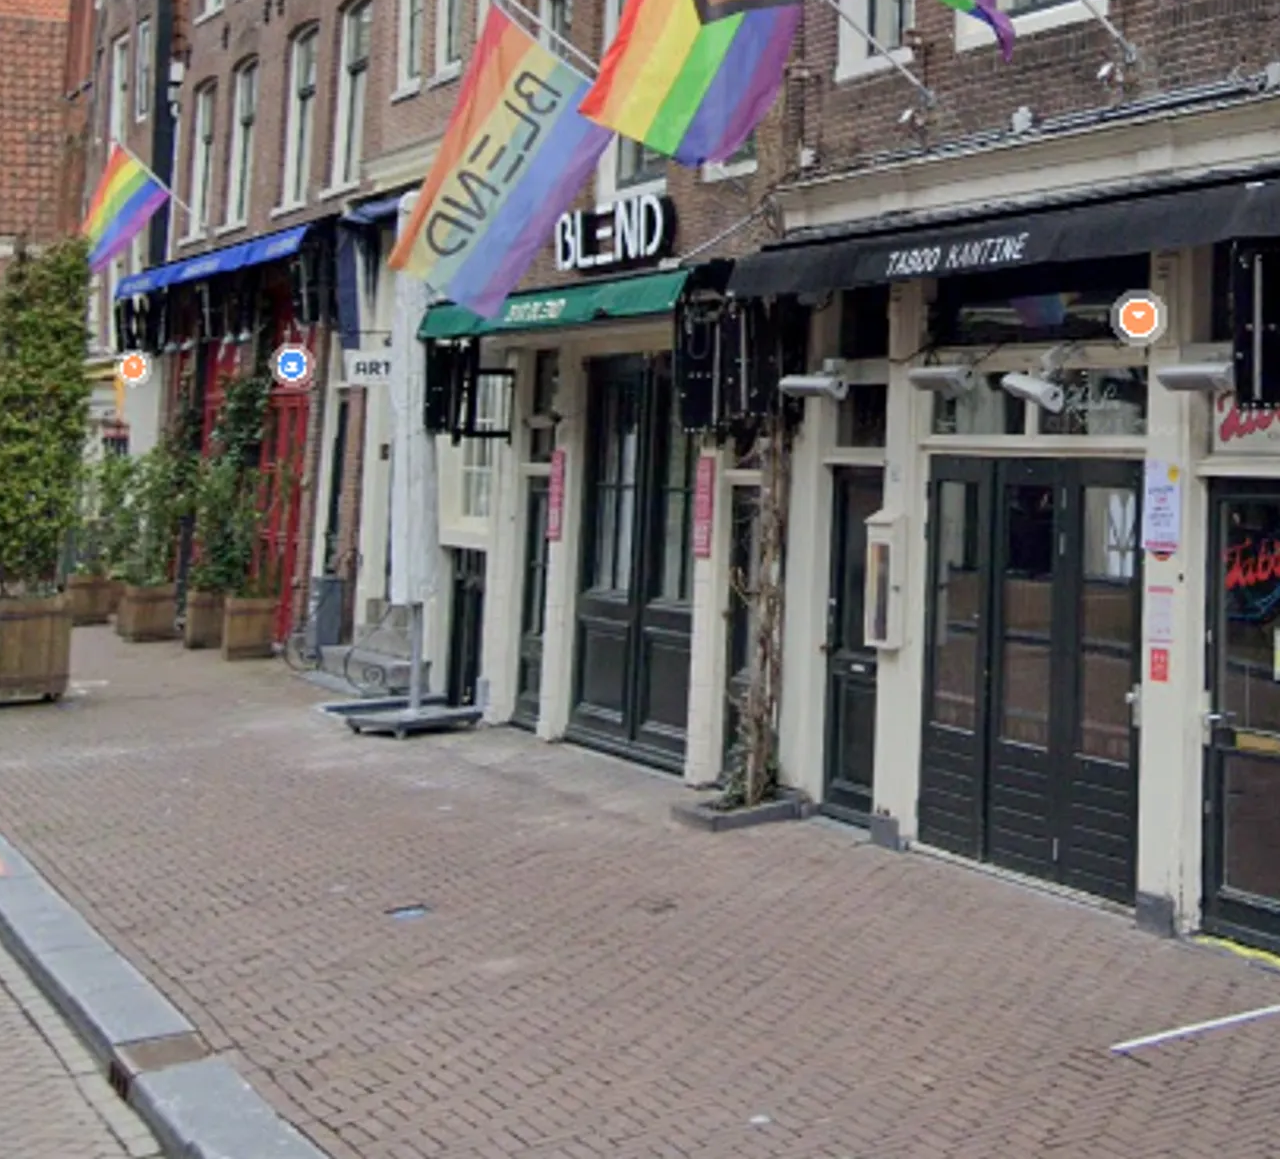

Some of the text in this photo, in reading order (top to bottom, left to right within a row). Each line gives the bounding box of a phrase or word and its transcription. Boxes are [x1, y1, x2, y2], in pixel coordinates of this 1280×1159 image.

[554, 193, 664, 271] BLEND
[885, 232, 1030, 277] TABOO KANTINE
